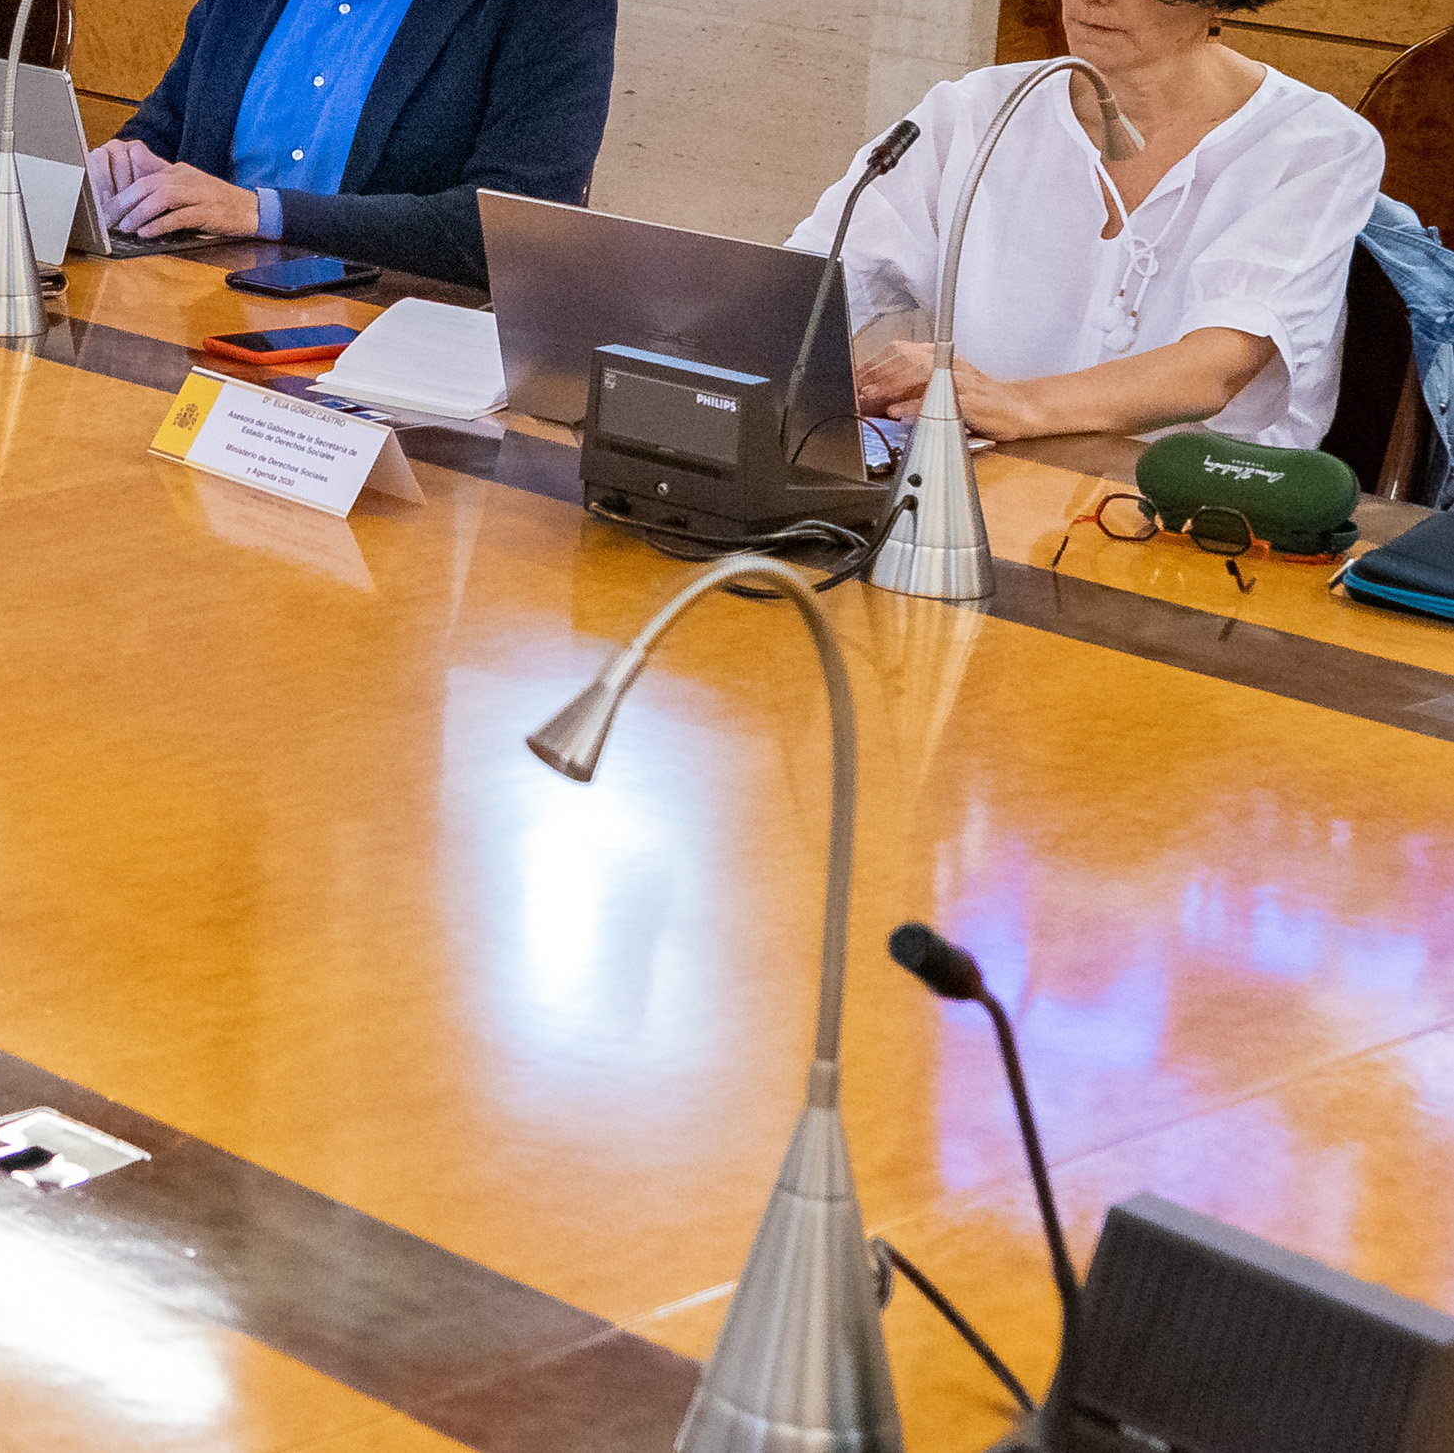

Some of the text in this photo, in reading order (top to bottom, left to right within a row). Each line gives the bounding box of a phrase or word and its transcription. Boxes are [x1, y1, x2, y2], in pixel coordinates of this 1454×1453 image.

[273, 399, 289, 411] ELIA
[316, 413, 347, 428] CASTRO
[696, 393, 737, 413] PHILIPS
[227, 411, 255, 424] Asesora
[255, 419, 267, 427] del
[267, 422, 296, 438] Gabinete
[296, 432, 306, 440] de
[306, 434, 313, 442] la
[348, 449, 357, 457] de
[241, 426, 335, 461] Estado de Derechos Sociales
[225, 443, 329, 483] Ministerio de Derechos Sociales
[251, 467, 278, 482] Agenda
[277, 476, 295, 487] 2030
